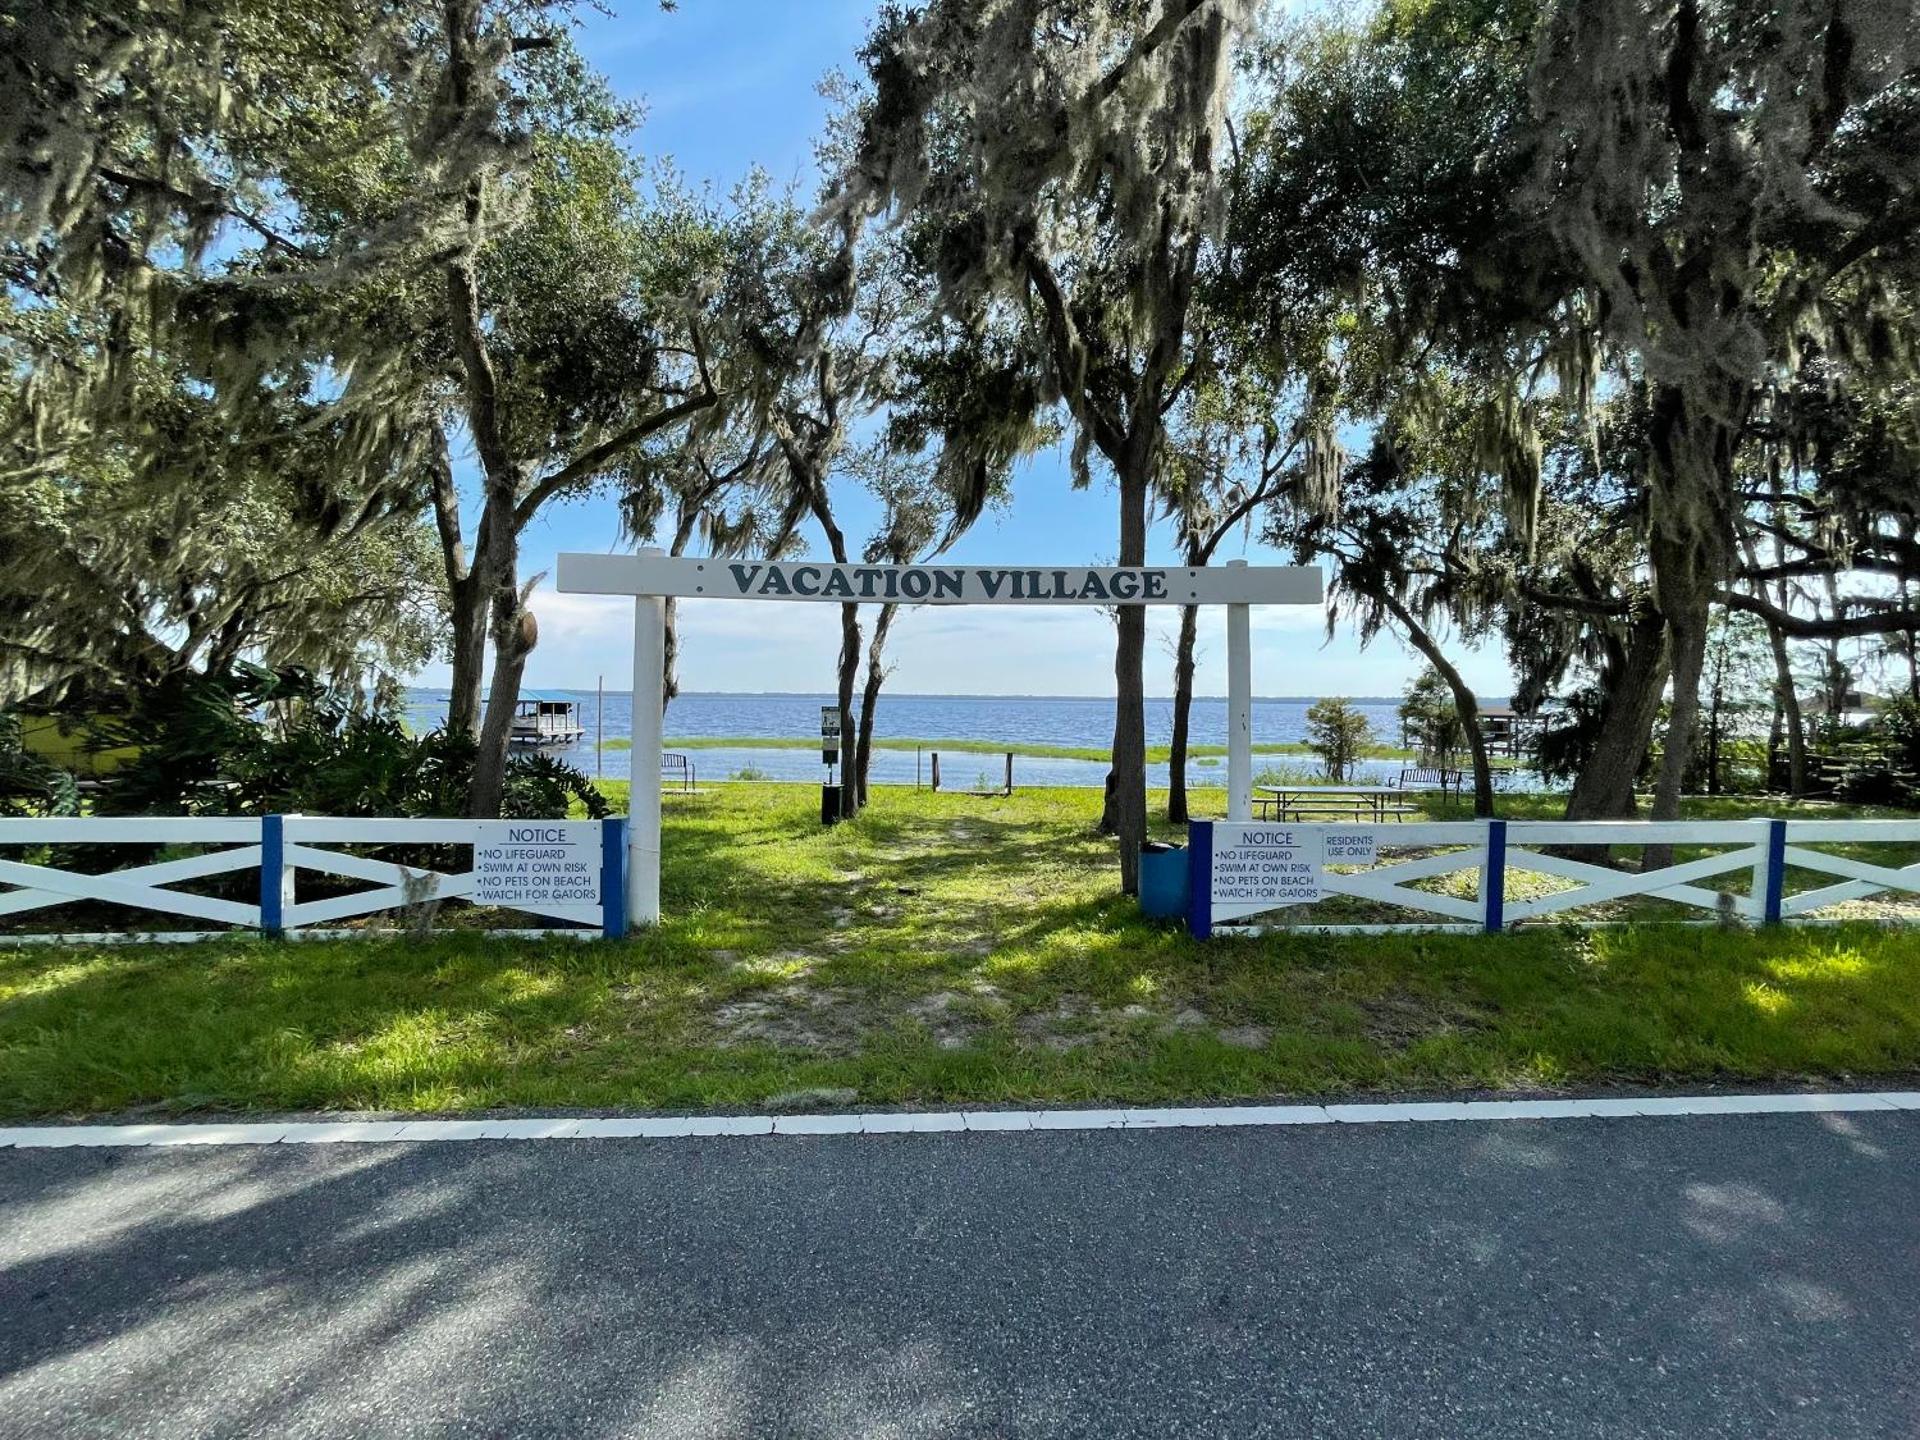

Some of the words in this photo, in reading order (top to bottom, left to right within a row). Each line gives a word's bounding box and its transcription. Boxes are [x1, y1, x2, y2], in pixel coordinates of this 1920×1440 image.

[728, 564, 966, 599] VACATION
[975, 569, 1168, 601] VILLAGE
[509, 829, 566, 842] NOTICE
[1243, 832, 1293, 844] NOTICE
[1327, 836, 1373, 845] RESIDENTS
[484, 850, 502, 859] NO
[505, 850, 565, 859] LIFEGUARD
[1220, 851, 1237, 860] NO
[1240, 851, 1292, 860] LIFEGUARD
[1328, 848, 1344, 856] USE
[1347, 847, 1371, 856] ONLY
[483, 863, 513, 872] SWIM
[516, 863, 529, 872] AT
[532, 863, 561, 872] OWN
[564, 863, 587, 872] RISK
[1219, 864, 1246, 872] SWIM
[1250, 864, 1259, 872] AT
[1262, 864, 1288, 872] OWN
[1291, 864, 1310, 872] RISK
[483, 876, 501, 886] NO
[505, 876, 528, 886] PETS
[532, 876, 550, 886] ON
[554, 876, 591, 886] BEACH
[1219, 877, 1235, 885] NO
[1238, 877, 1258, 885] PETS
[1262, 877, 1278, 885] ON
[1281, 877, 1314, 885] BEACH
[483, 890, 522, 900] WATCH
[526, 890, 548, 900] FOR
[552, 889, 596, 899] GATORS
[1219, 889, 1252, 897] WATCH
[1256, 889, 1276, 897] FOR
[1279, 888, 1318, 897] GATORS
